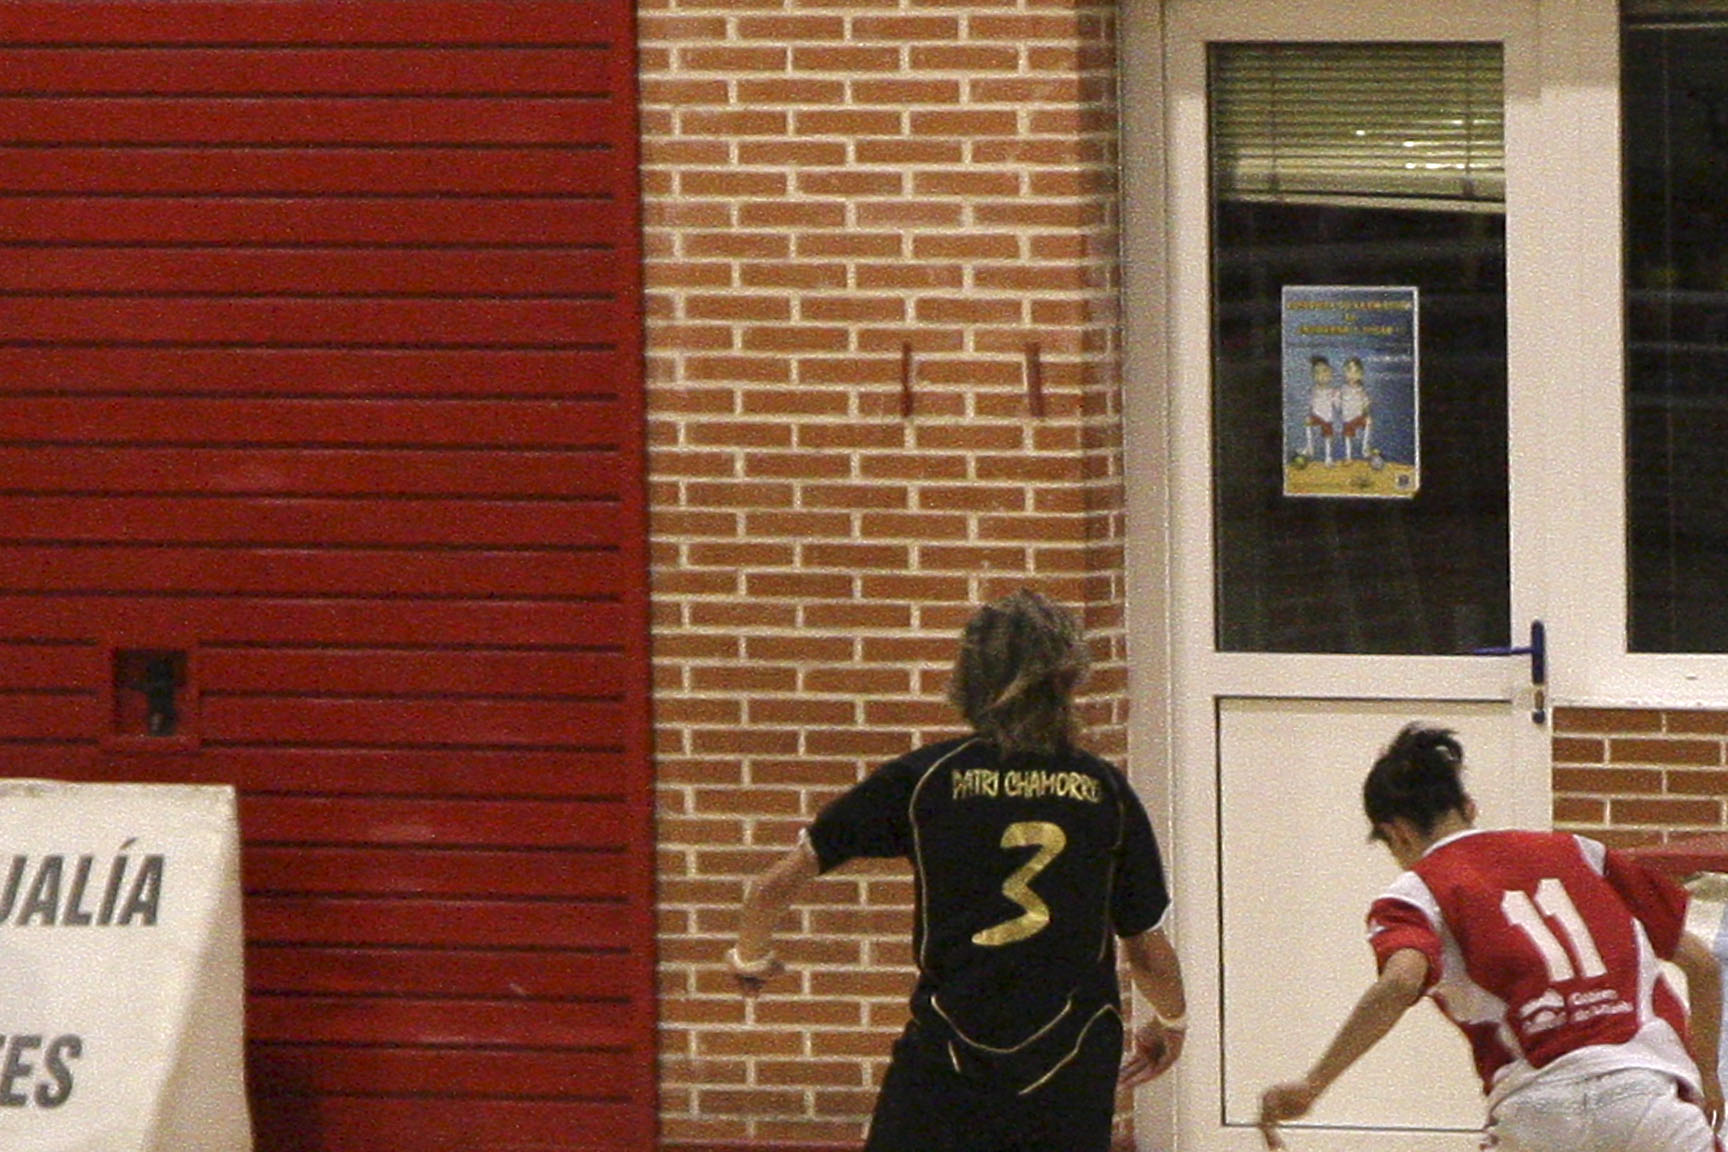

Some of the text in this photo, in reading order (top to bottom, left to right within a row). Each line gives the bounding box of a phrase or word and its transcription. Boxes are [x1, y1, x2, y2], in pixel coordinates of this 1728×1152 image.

[951, 768, 1000, 800] PATRI
[971, 821, 1067, 946] 3
[1501, 877, 1608, 983] 11
[0, 1034, 83, 1108] ES
